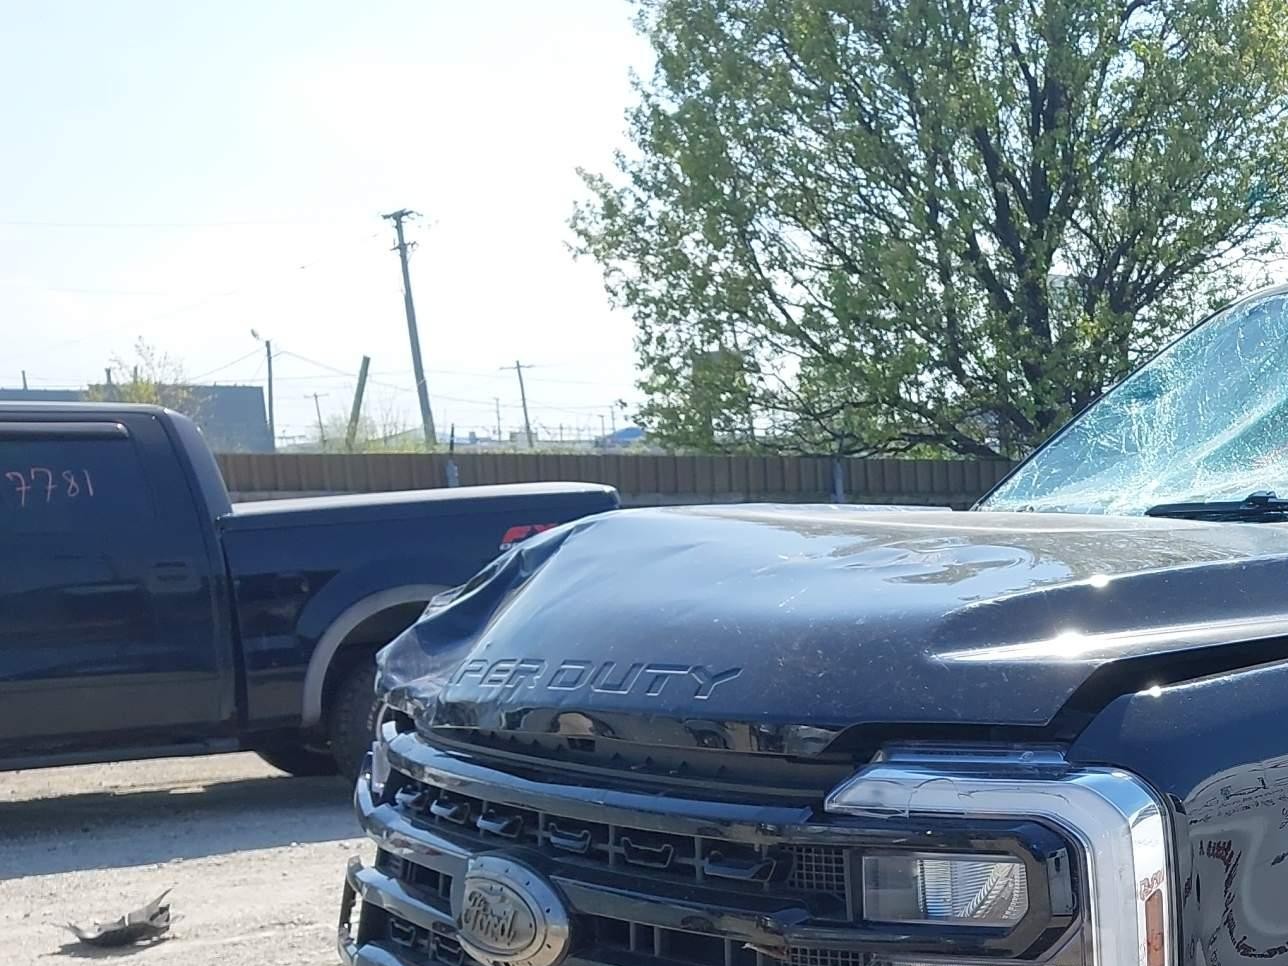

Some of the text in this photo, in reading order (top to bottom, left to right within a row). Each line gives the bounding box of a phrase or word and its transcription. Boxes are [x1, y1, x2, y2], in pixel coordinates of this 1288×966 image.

[5, 465, 94, 507] 7781
[546, 658, 746, 700] DUTY
[463, 890, 519, 947] Ford
